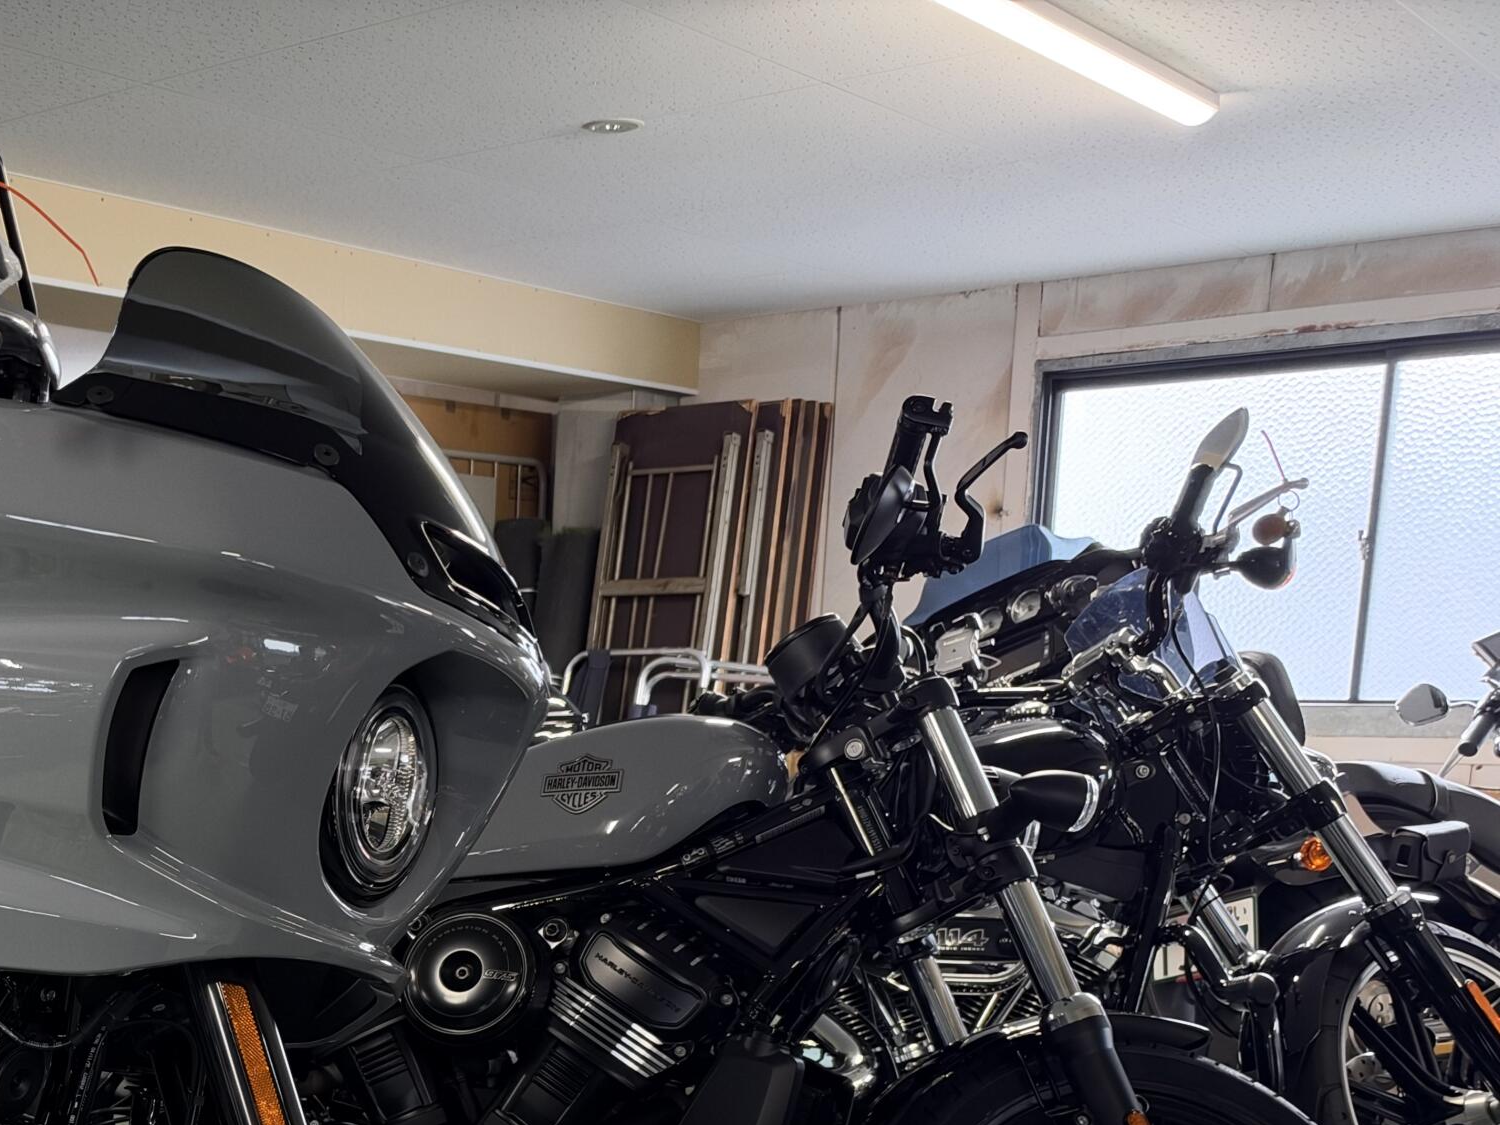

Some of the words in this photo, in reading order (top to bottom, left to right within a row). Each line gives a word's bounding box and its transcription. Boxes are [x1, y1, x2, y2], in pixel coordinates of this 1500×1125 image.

[566, 759, 603, 774] MOTOR
[546, 774, 618, 791] HARLEY-DAVIDSON
[560, 792, 598, 808] CYCLES
[936, 927, 990, 947] 114
